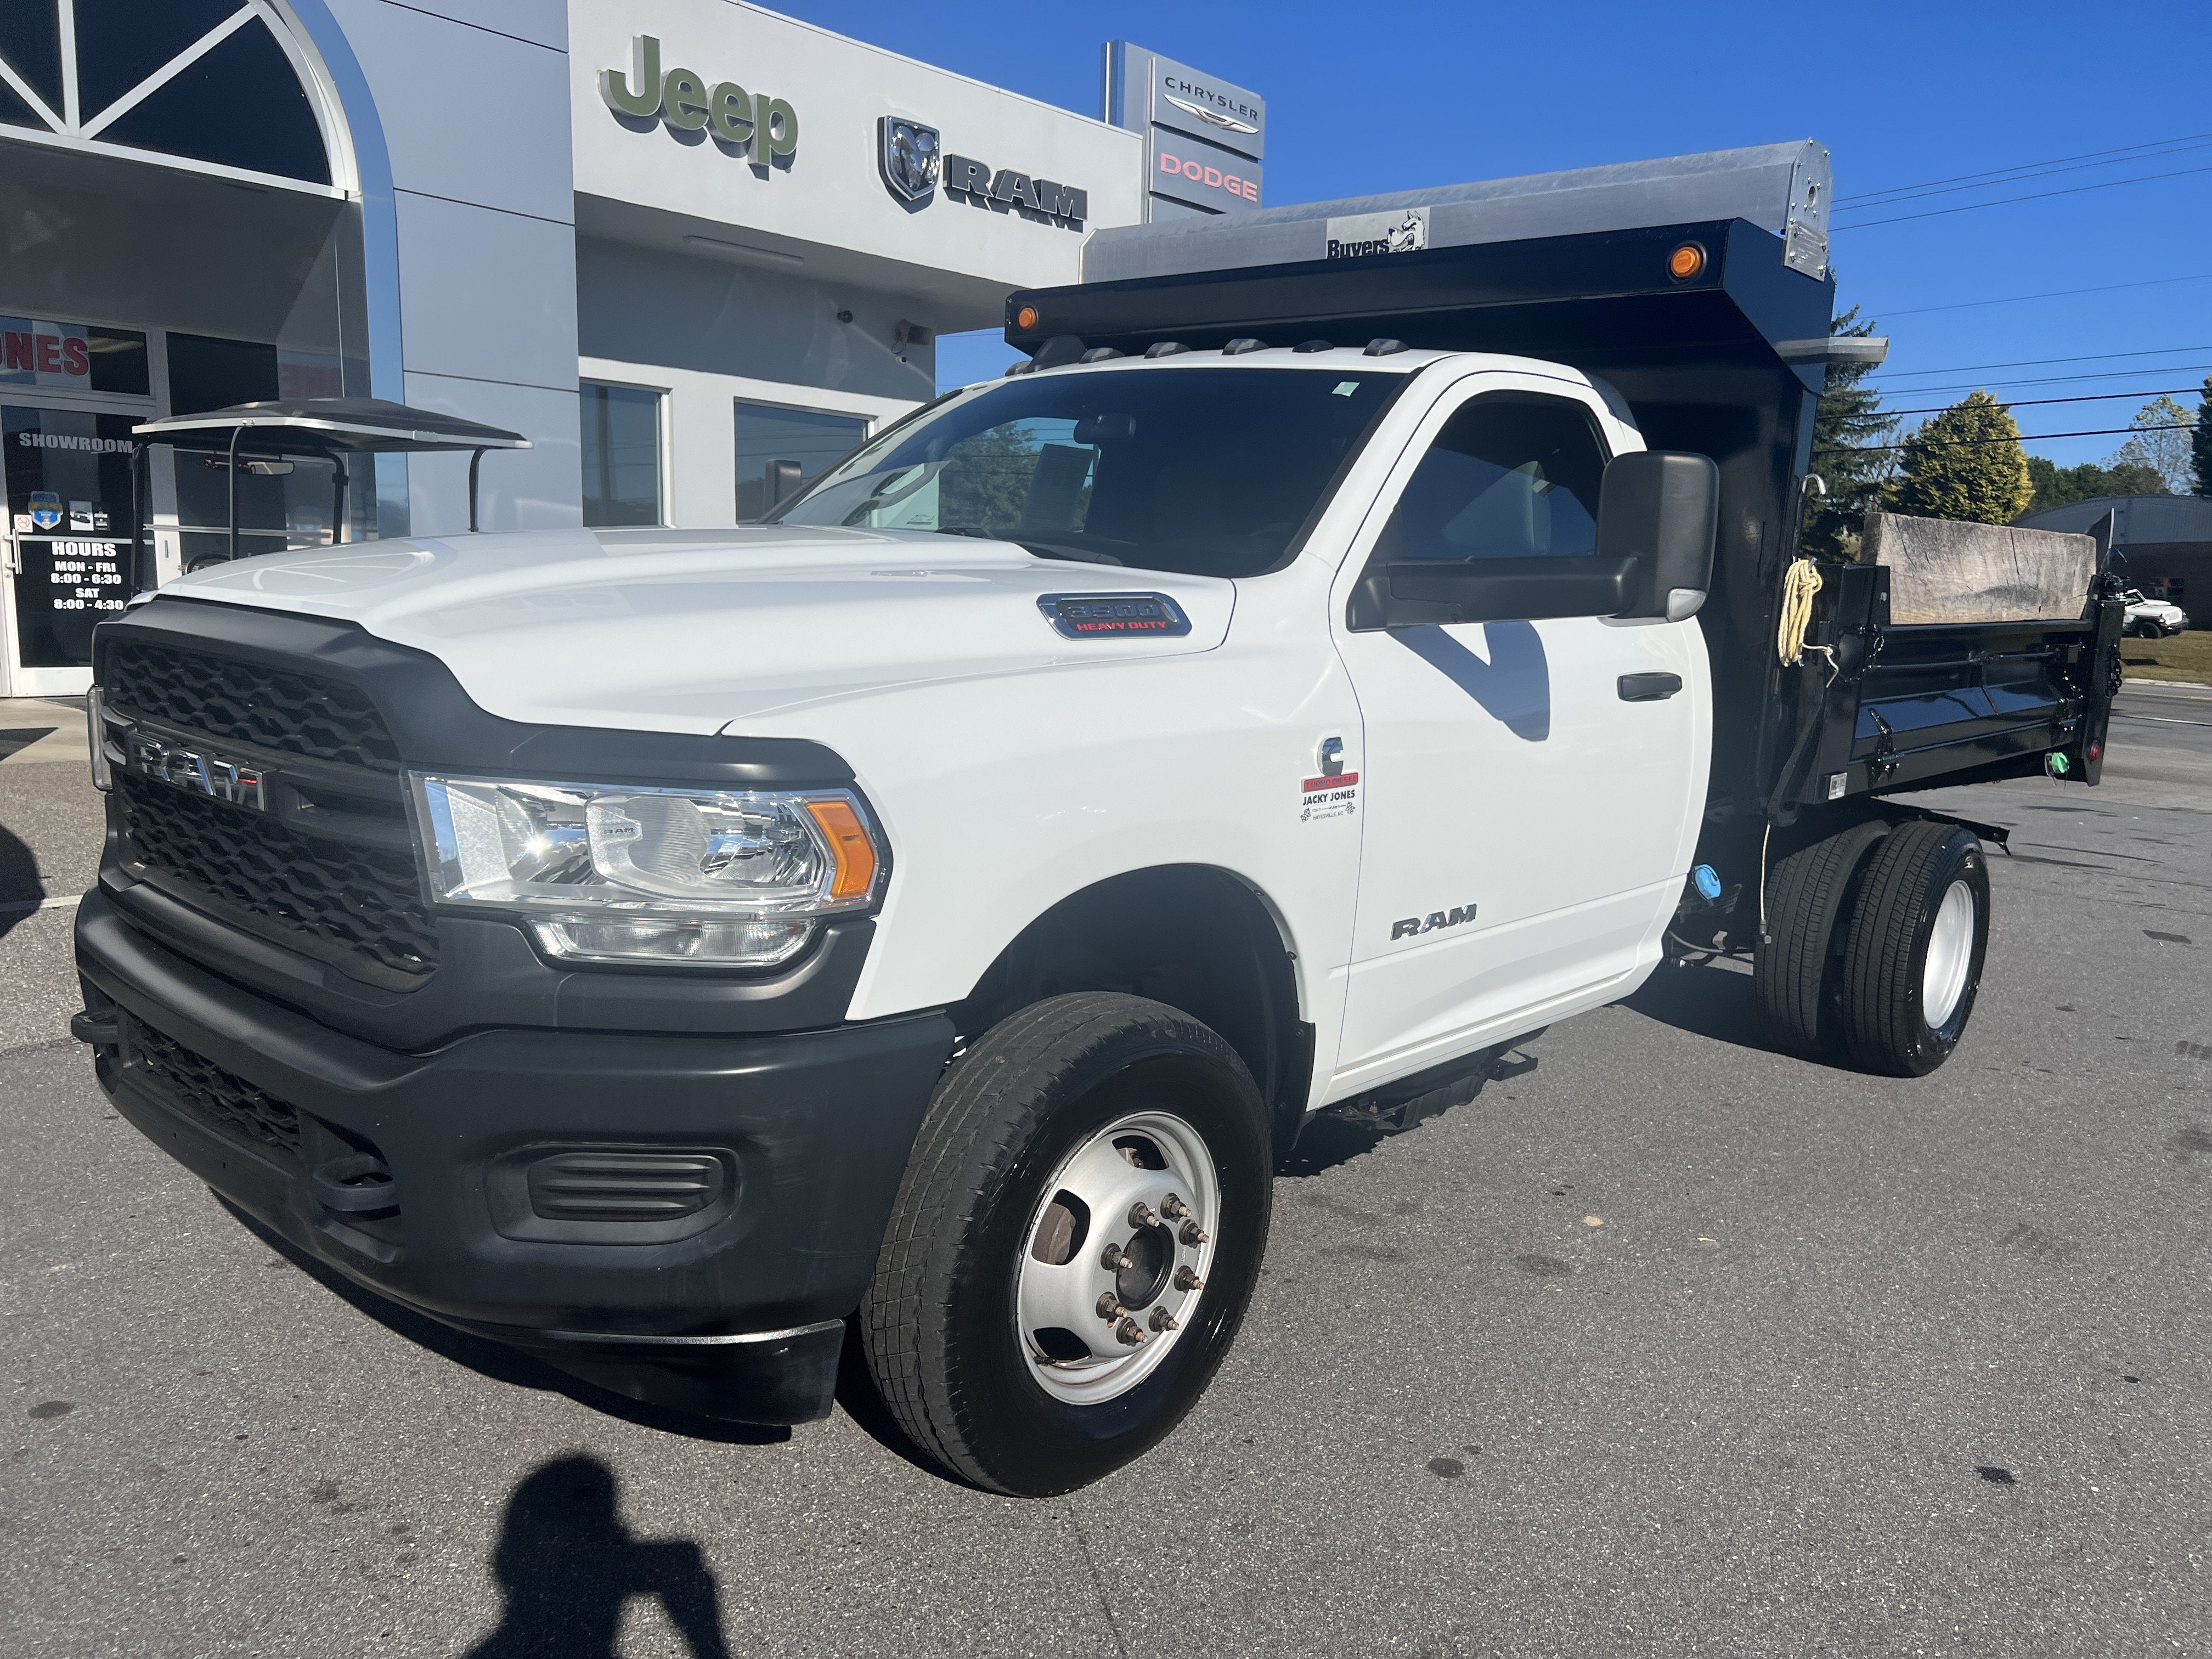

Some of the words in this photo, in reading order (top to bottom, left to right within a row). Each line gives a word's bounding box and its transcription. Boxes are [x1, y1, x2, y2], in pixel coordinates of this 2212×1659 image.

[597, 35, 798, 165] Jeep
[1165, 77, 1259, 121] CHRYSLER
[944, 154, 1087, 221] RAM
[1160, 152, 1258, 202] DODGE
[0, 331, 89, 376] NES
[19, 432, 133, 454] SHOWROOM
[52, 541, 116, 557] HOURS
[55, 561, 86, 572] MON
[95, 562, 116, 572] FRI
[50, 573, 82, 584] 8:00
[92, 574, 122, 585] 6:30
[75, 588, 100, 598] SAT
[54, 599, 84, 610] 8:00
[94, 599, 124, 610] 4:30
[1076, 622, 1125, 631] HEAVY
[1127, 621, 1166, 629] DUTY
[137, 739, 266, 811] RAM
[1302, 793, 1328, 806] JACKY
[1329, 789, 1355, 802] JONES
[1390, 903, 1477, 941] RAM
